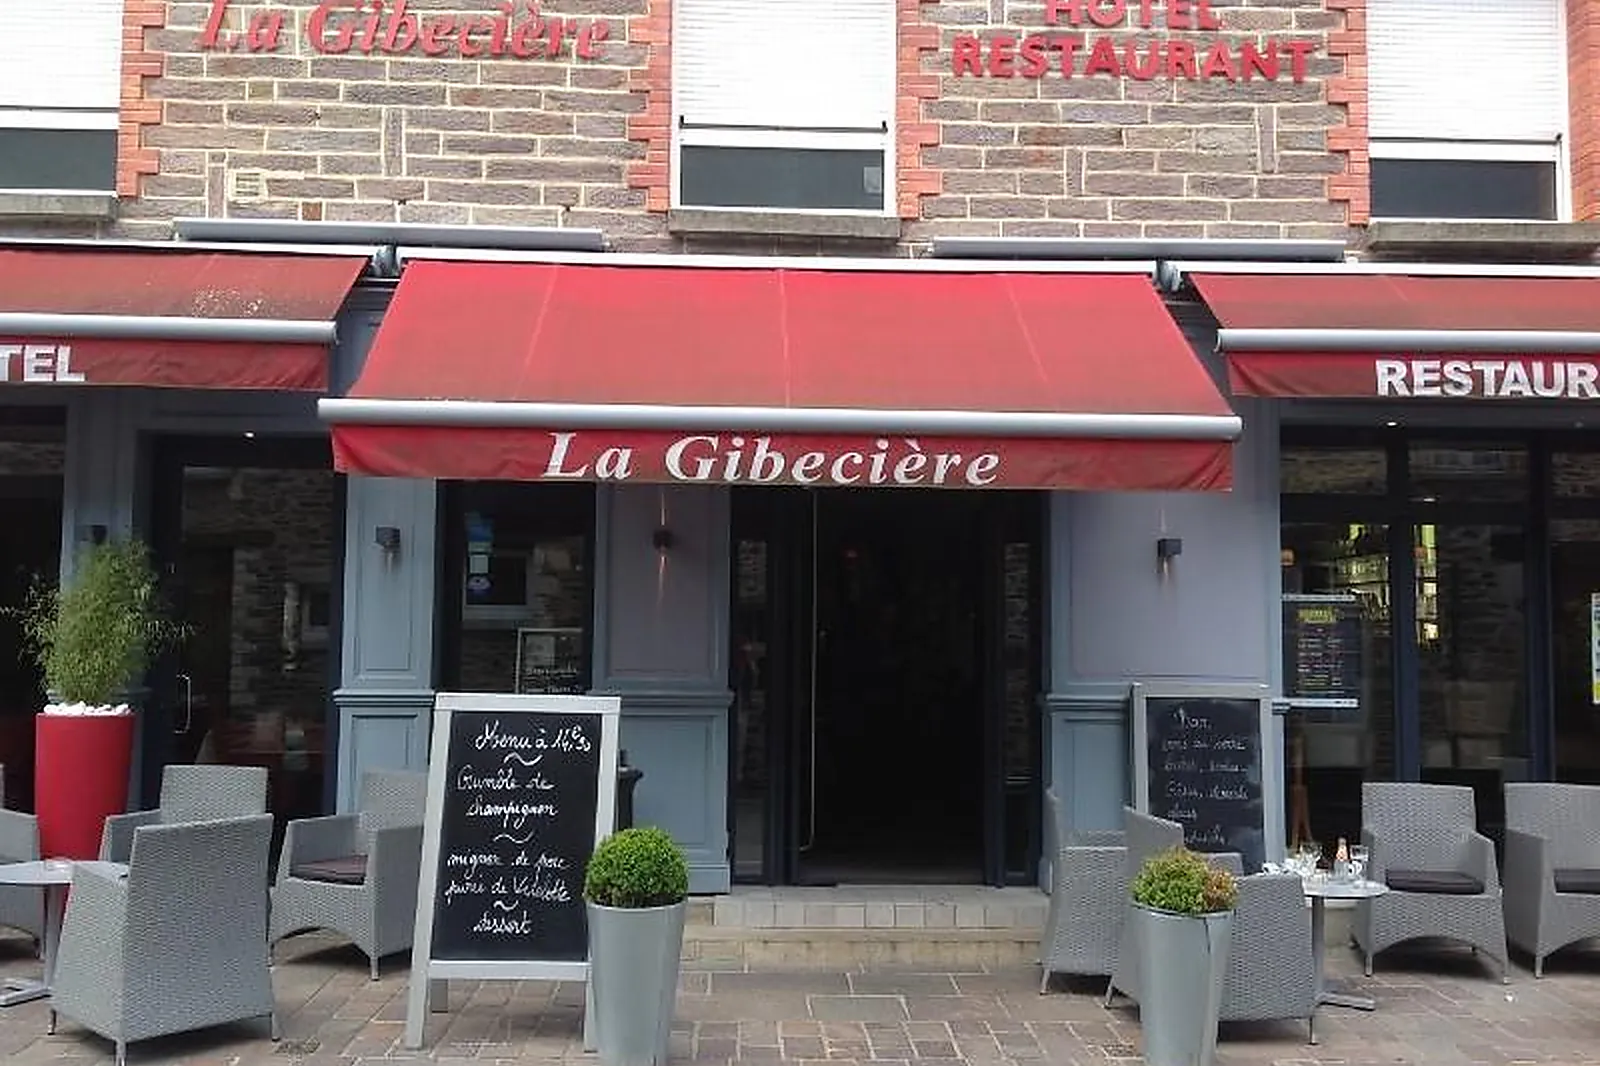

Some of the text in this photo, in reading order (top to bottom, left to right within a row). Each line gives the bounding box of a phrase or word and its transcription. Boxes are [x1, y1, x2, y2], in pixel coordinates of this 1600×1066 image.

[199, 0, 285, 52] La
[952, 35, 1312, 83] RESTAURANT
[1375, 358, 1600, 398] RESTAUR
[541, 431, 1000, 487] La Gibecière
